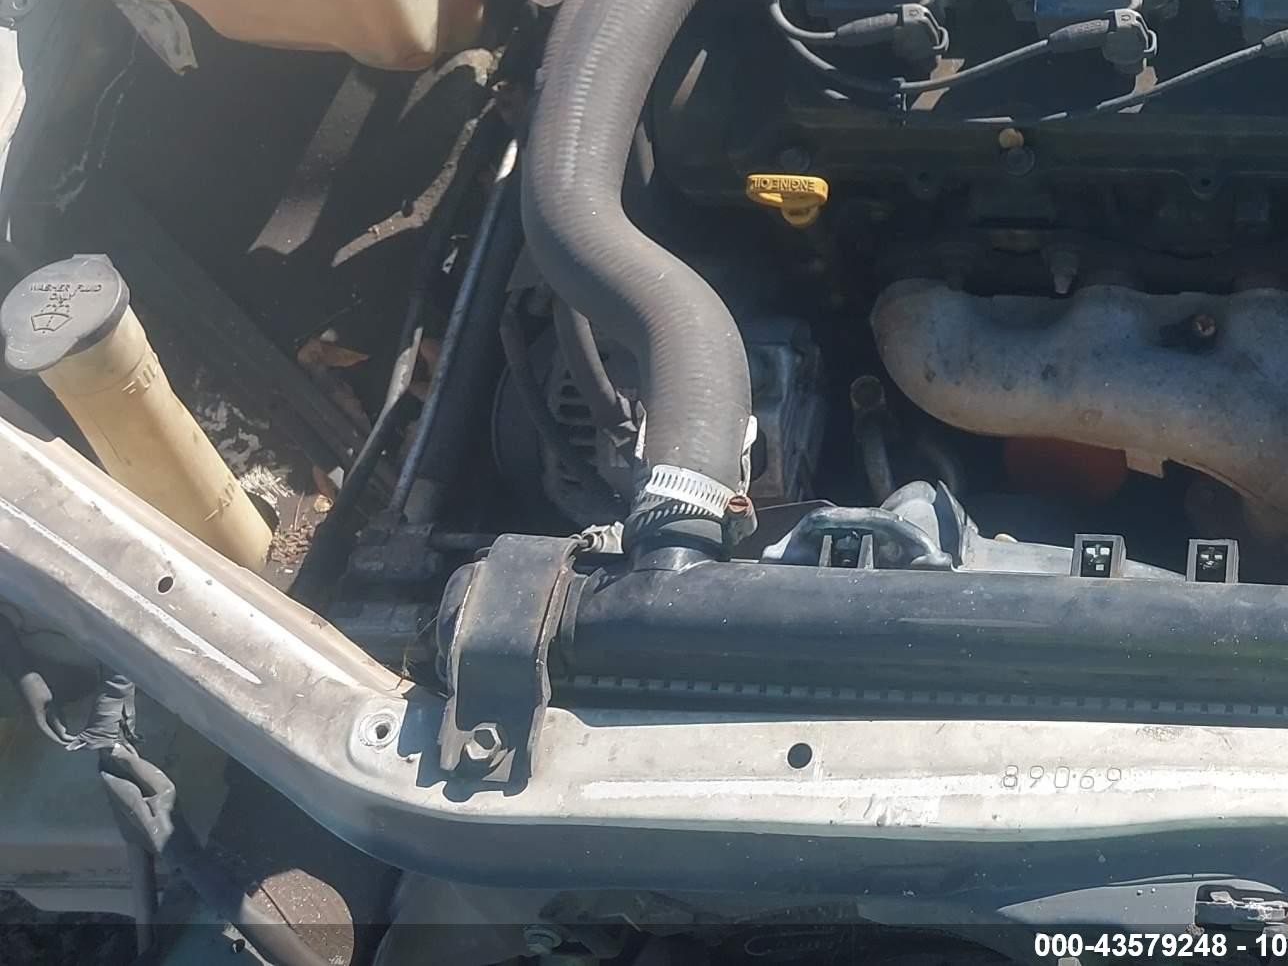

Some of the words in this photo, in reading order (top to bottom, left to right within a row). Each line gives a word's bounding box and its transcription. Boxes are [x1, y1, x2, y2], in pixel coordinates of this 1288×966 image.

[751, 177, 771, 190] OIL
[772, 179, 816, 192] ENGINE
[30, 283, 70, 293] WASHER
[77, 283, 103, 293] FLUID
[1002, 764, 1122, 792] 89069
